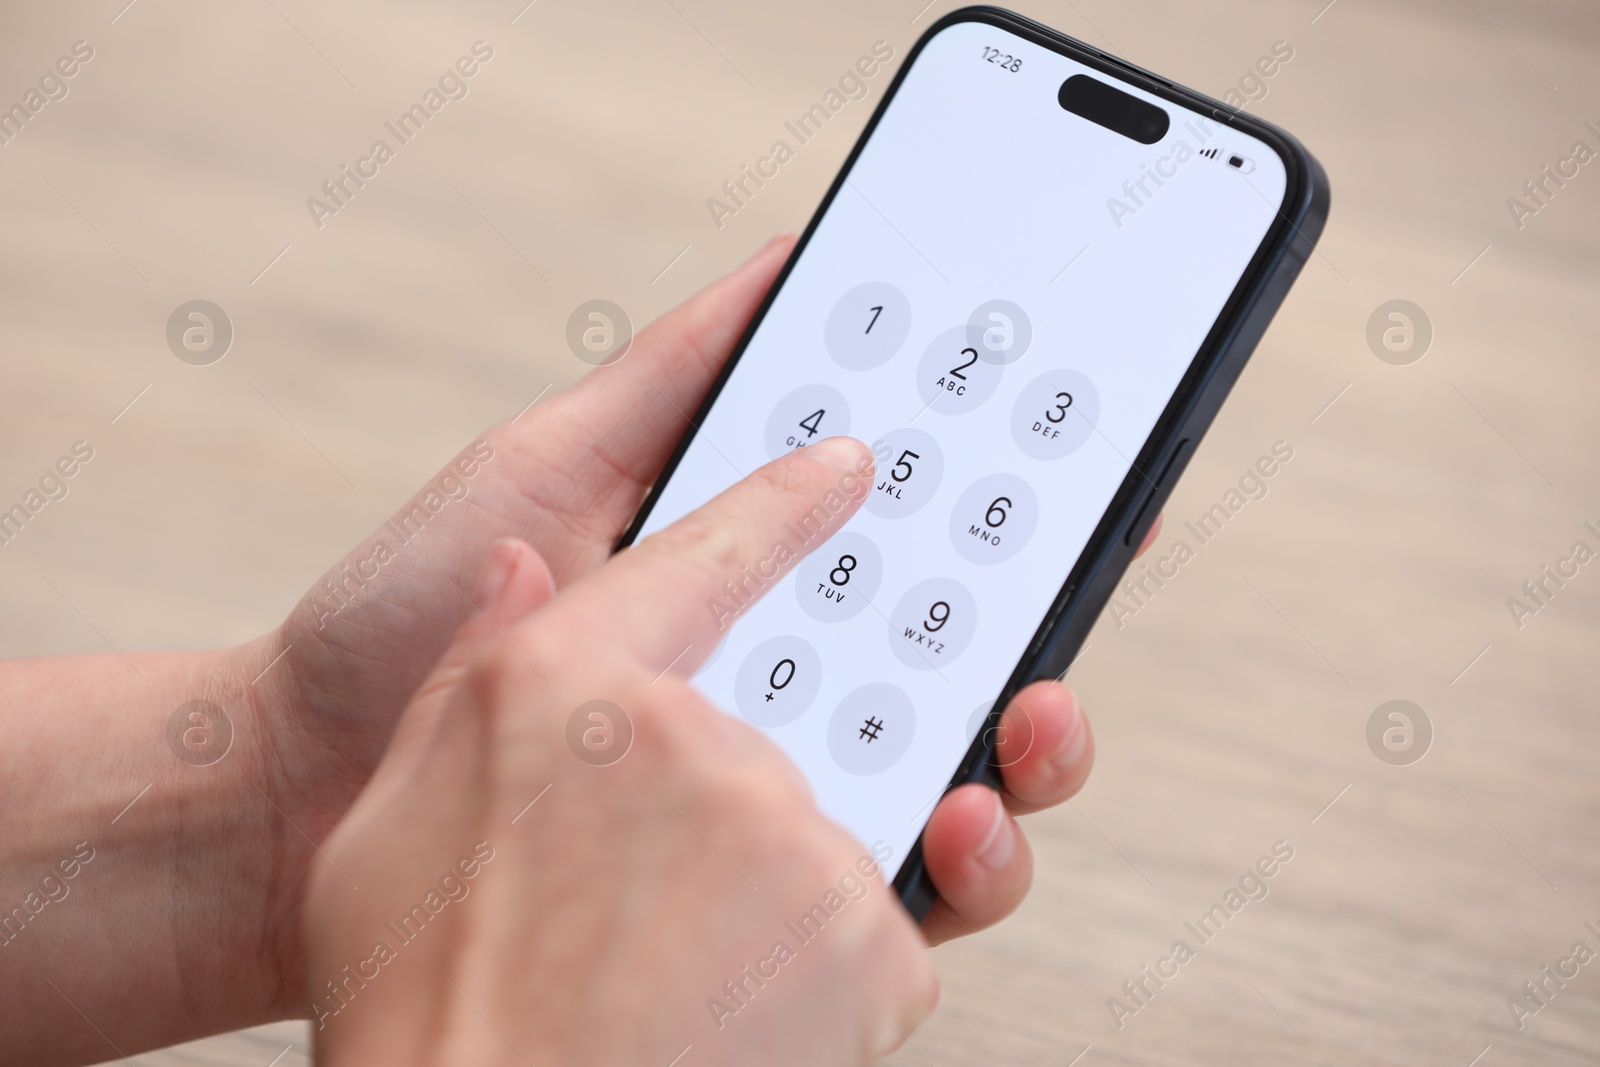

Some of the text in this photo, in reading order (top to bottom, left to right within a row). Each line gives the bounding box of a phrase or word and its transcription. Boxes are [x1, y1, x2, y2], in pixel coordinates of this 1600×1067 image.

[982, 46, 1023, 73] 12:28
[864, 305, 884, 335] 1
[949, 347, 979, 381] 2
[936, 376, 967, 397] ABC
[1045, 392, 1074, 424] 3
[799, 408, 826, 439] 4
[1031, 421, 1061, 440] DEF
[890, 449, 920, 483] 5
[876, 481, 902, 500] JKL
[984, 496, 1013, 529] 6
[967, 524, 1001, 547] MNO
[829, 554, 857, 587] 8
[816, 582, 846, 604] TUV
[923, 600, 951, 633] 9
[903, 626, 945, 655] WXYZ
[769, 658, 796, 691] 0
[859, 715, 884, 744] #
